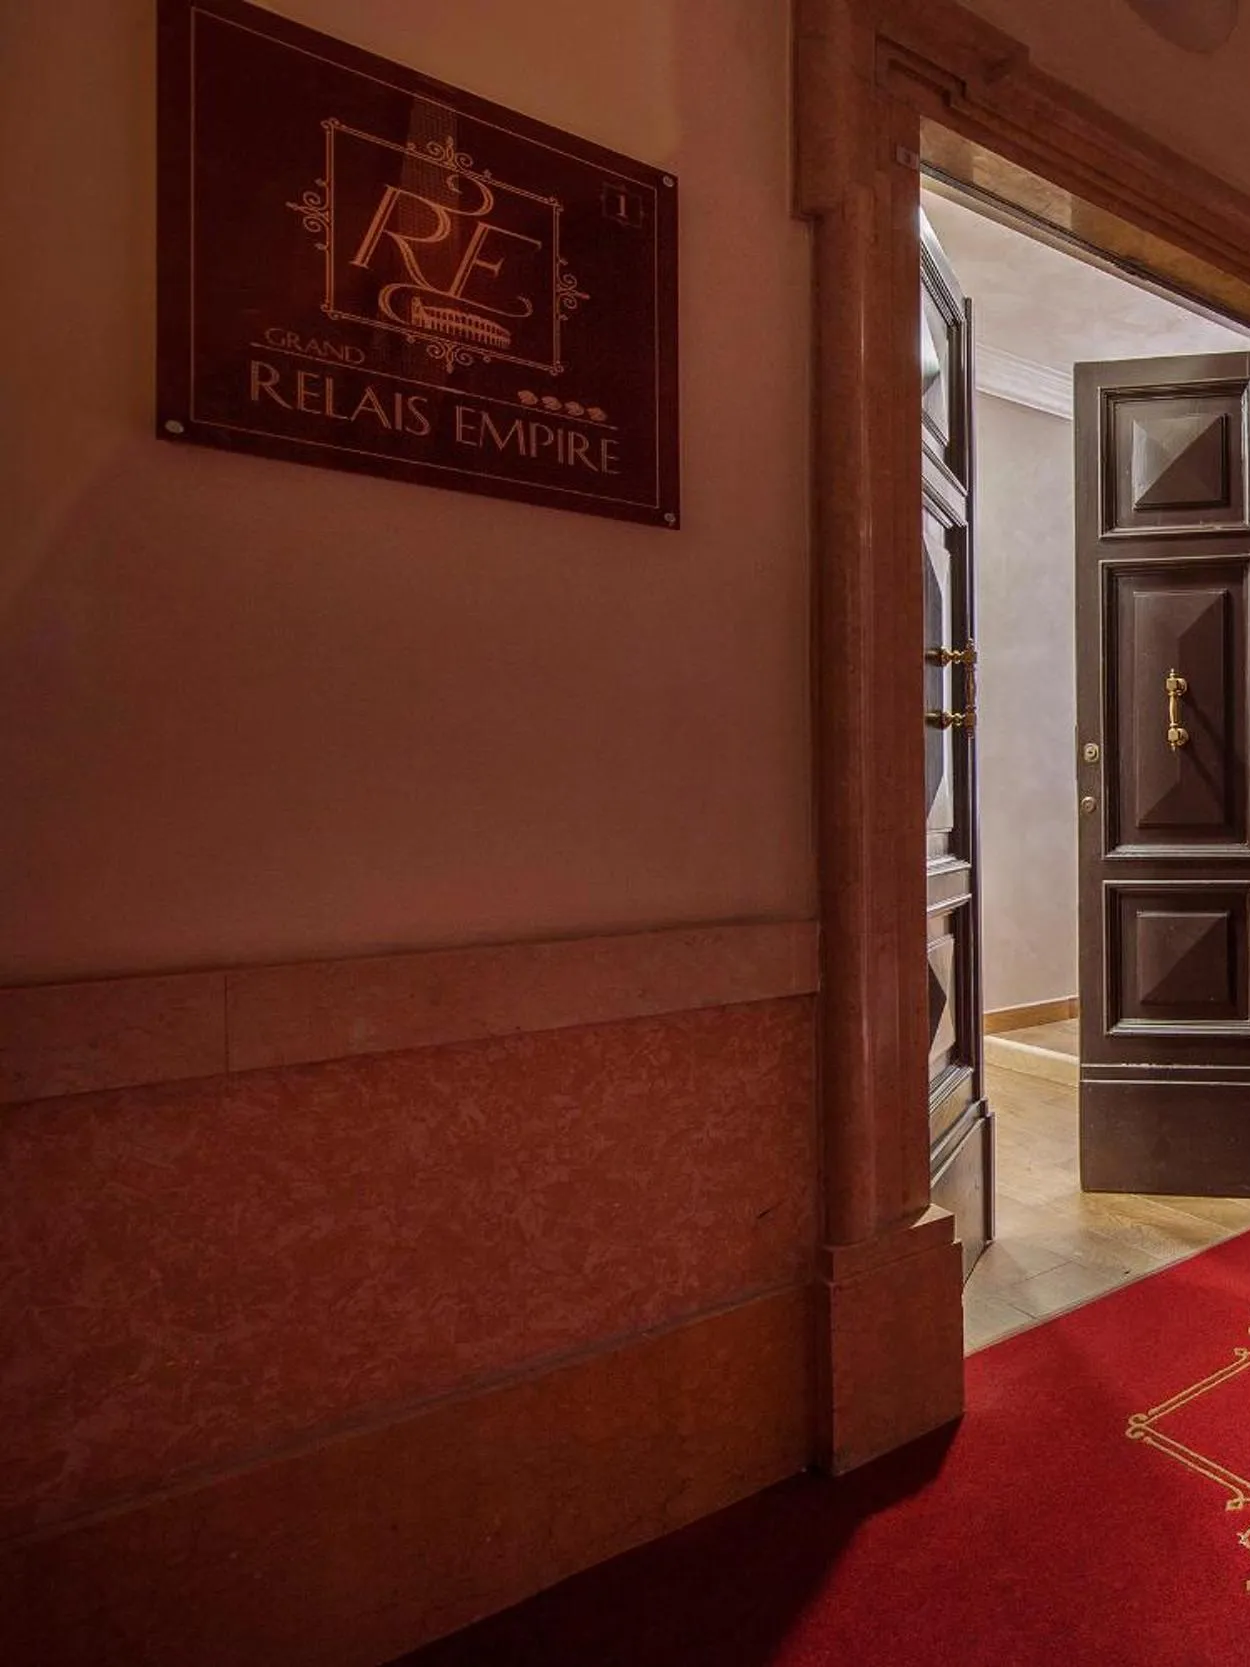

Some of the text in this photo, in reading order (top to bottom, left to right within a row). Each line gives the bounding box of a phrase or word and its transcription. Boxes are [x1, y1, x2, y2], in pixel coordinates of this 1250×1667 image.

[264, 328, 366, 365] GRAND
[251, 360, 621, 475] RELAIS EMPIRE
